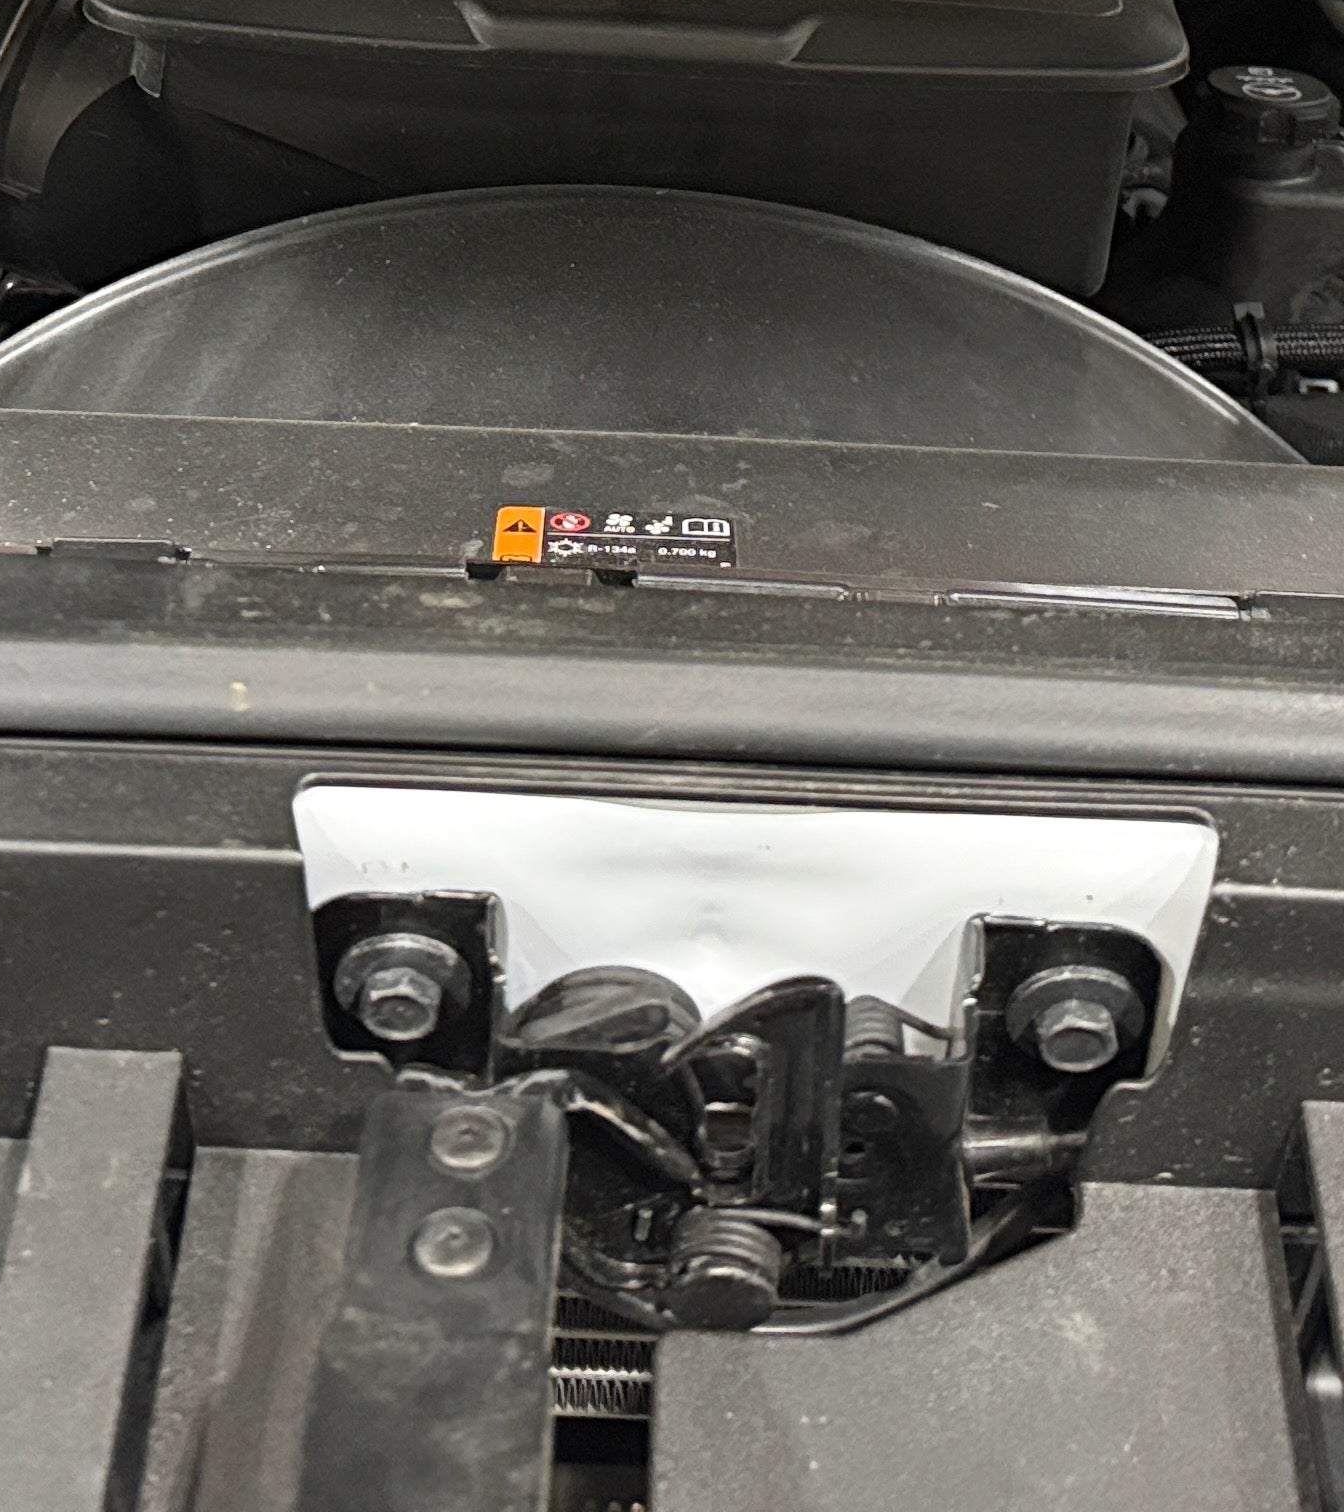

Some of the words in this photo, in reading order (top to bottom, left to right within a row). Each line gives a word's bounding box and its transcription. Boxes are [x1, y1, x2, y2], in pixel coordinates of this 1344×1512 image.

[603, 525, 636, 534] AUTO
[587, 544, 637, 555] R-134a
[657, 547, 697, 557] 0.700
[699, 548, 717, 559] kg
